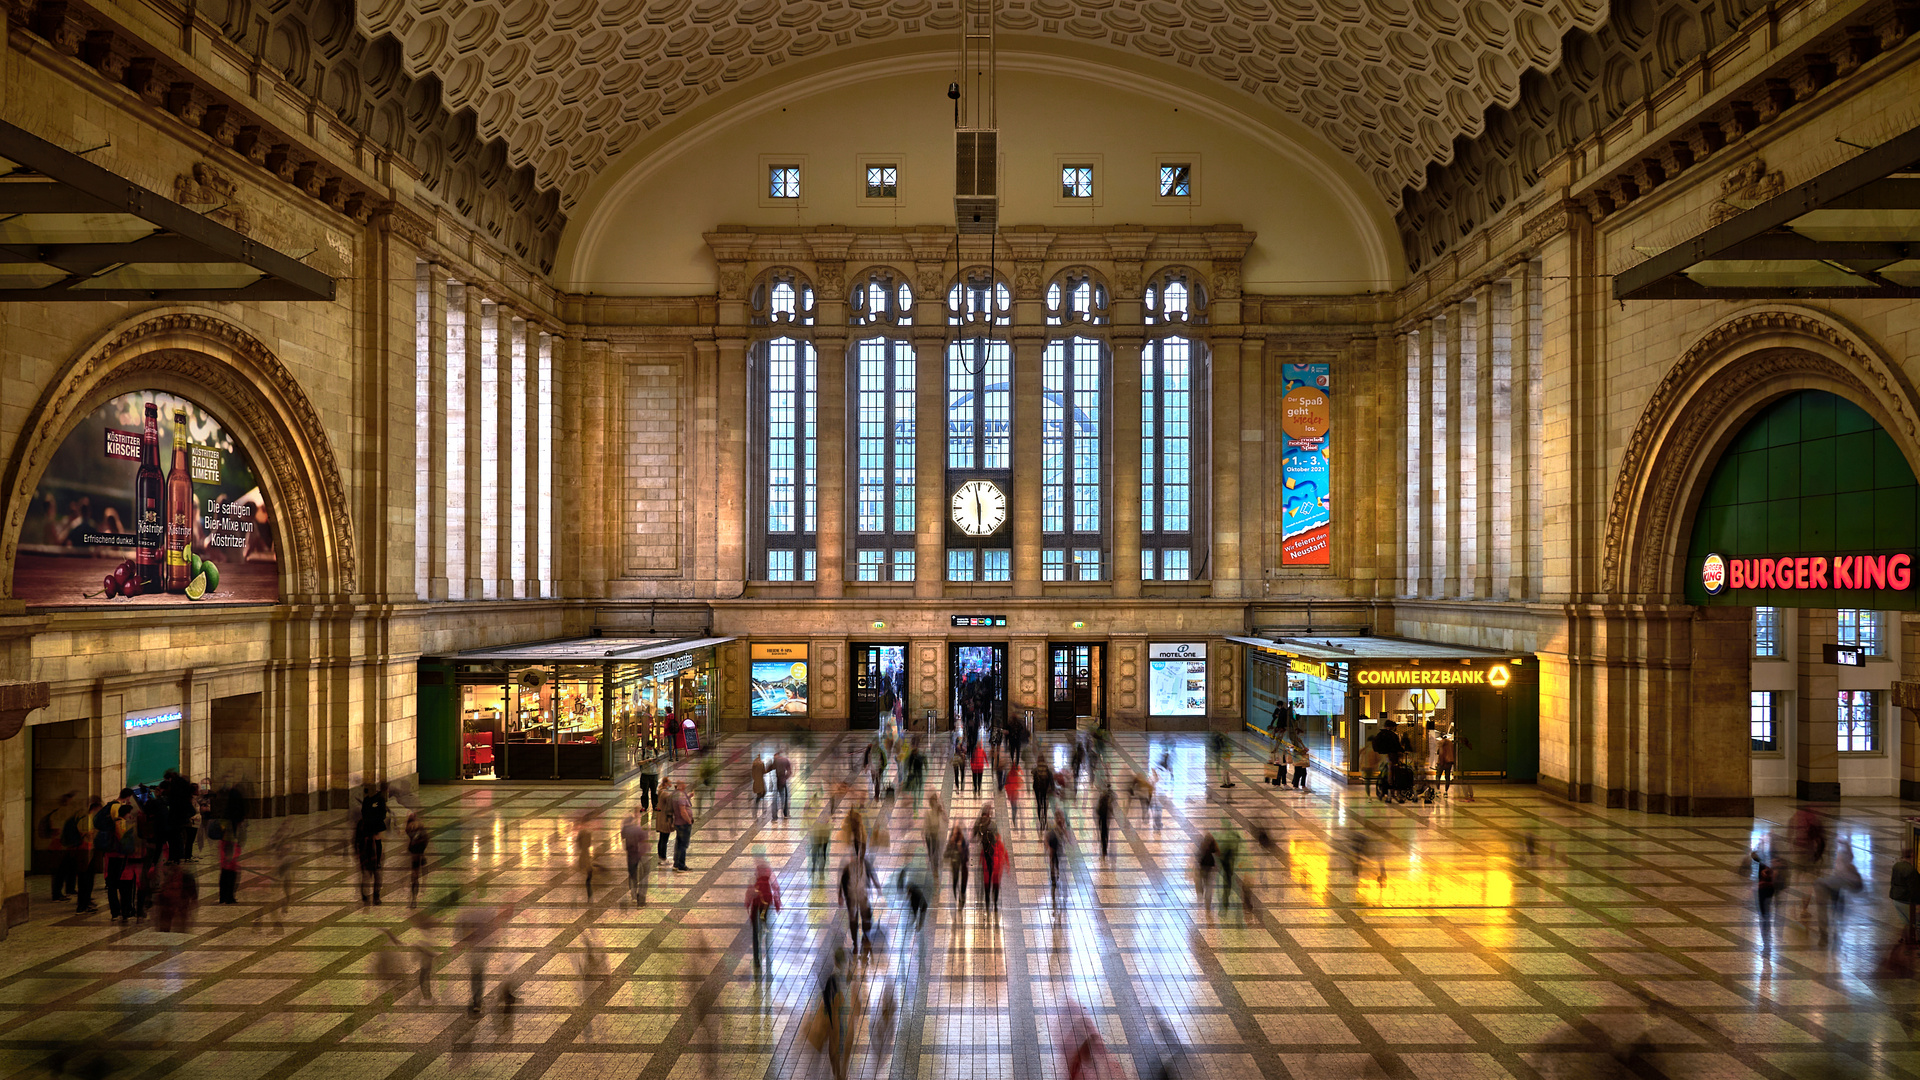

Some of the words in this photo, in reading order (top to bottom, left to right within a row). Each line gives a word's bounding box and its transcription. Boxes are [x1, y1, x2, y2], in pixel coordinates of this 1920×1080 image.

[1300, 396, 1322, 407] Spaß
[1288, 407, 1308, 417] geht
[1294, 412, 1322, 424] wieder
[107, 432, 140, 446] KÖSTRITZER
[107, 442, 140, 458] KIRSCHE
[192, 447, 220, 458] KÖSTRITZER
[192, 456, 218, 470] RADLER
[1310, 456, 1320, 466] 3.
[192, 468, 220, 482] LIMETTE
[208, 500, 220, 514] Die
[222, 502, 250, 518] saftigen
[204, 516, 238, 530] Bier-Mixe
[240, 522, 253, 532] von
[84, 534, 114, 544] Erfrischend
[116, 536, 134, 544] dunkel.
[212, 533, 246, 548] Köstritzer.
[1294, 536, 1316, 548] feiern
[1290, 540, 1326, 560] Neustart!
[1704, 571, 1722, 582] KING
[1729, 556, 1828, 590] BURGER
[1833, 554, 1911, 590] KING
[1358, 670, 1484, 684] COMMERZBANK
